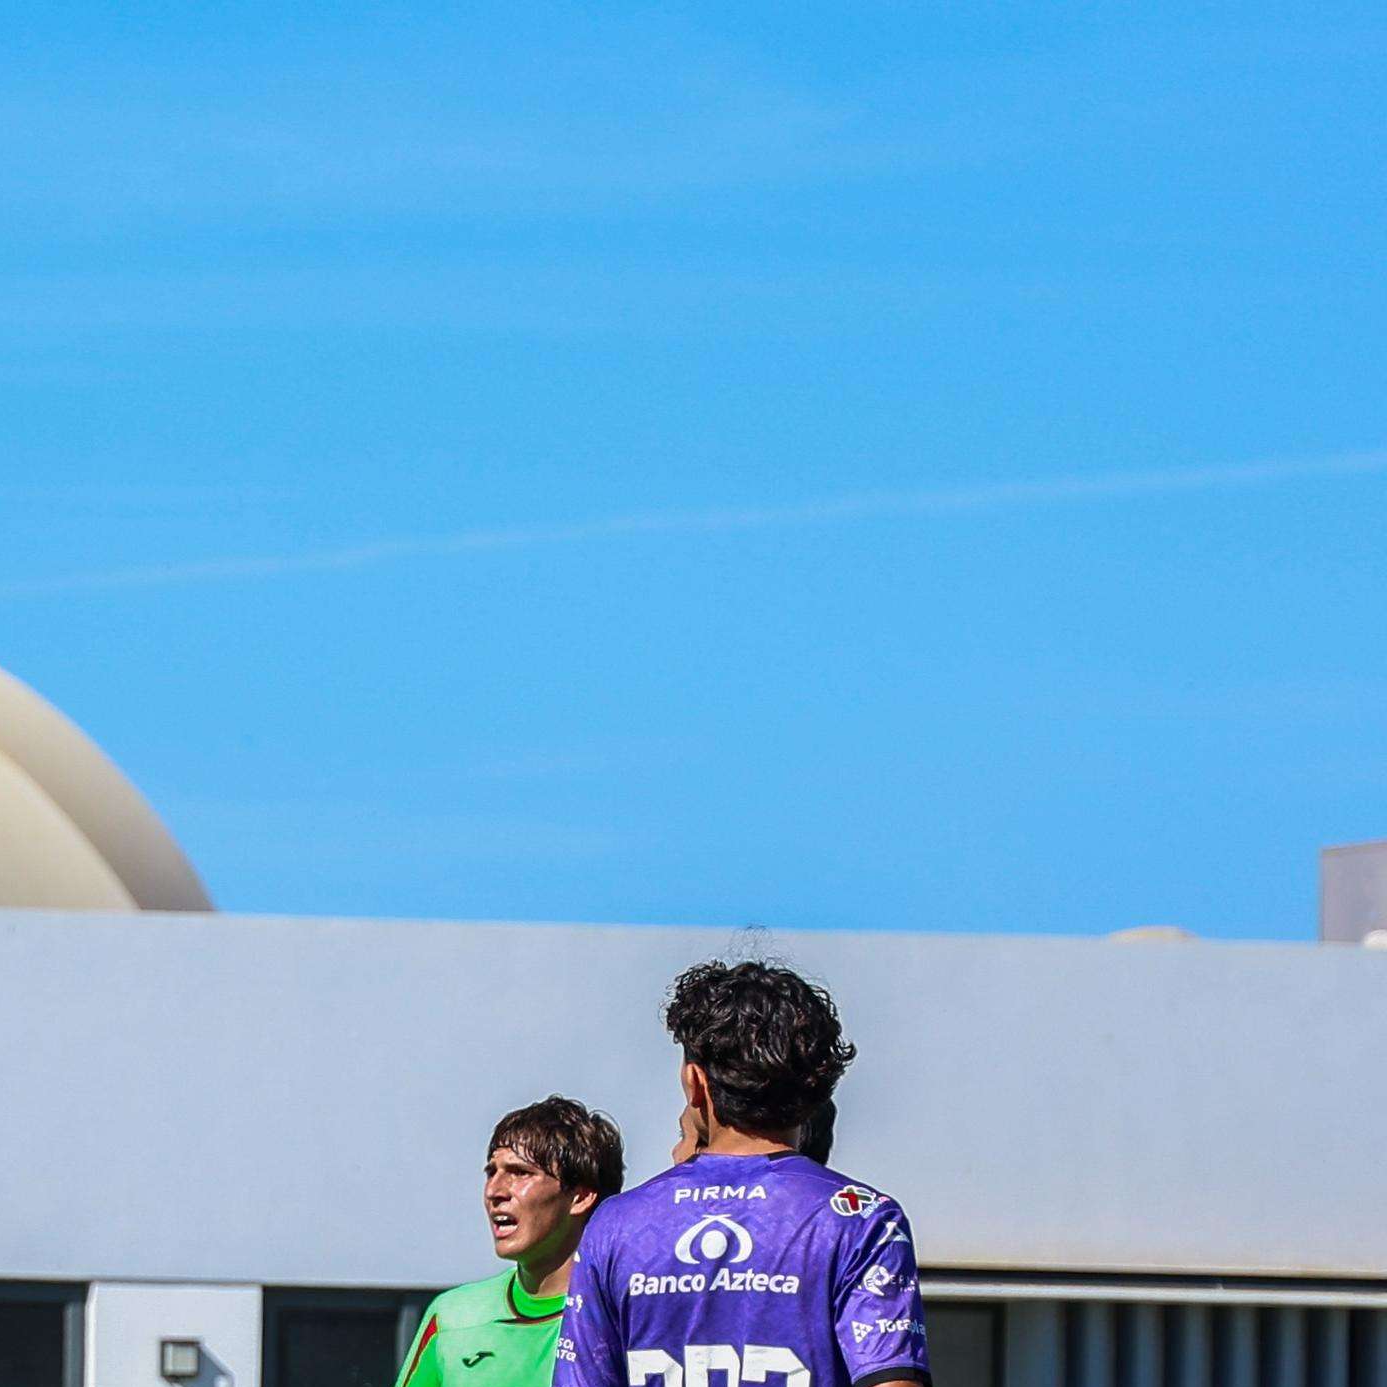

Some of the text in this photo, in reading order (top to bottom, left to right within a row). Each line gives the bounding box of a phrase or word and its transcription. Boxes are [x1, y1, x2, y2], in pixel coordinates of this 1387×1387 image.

[674, 1185, 767, 1205] PIRMA
[629, 1268, 800, 1296] Banco Azteca
